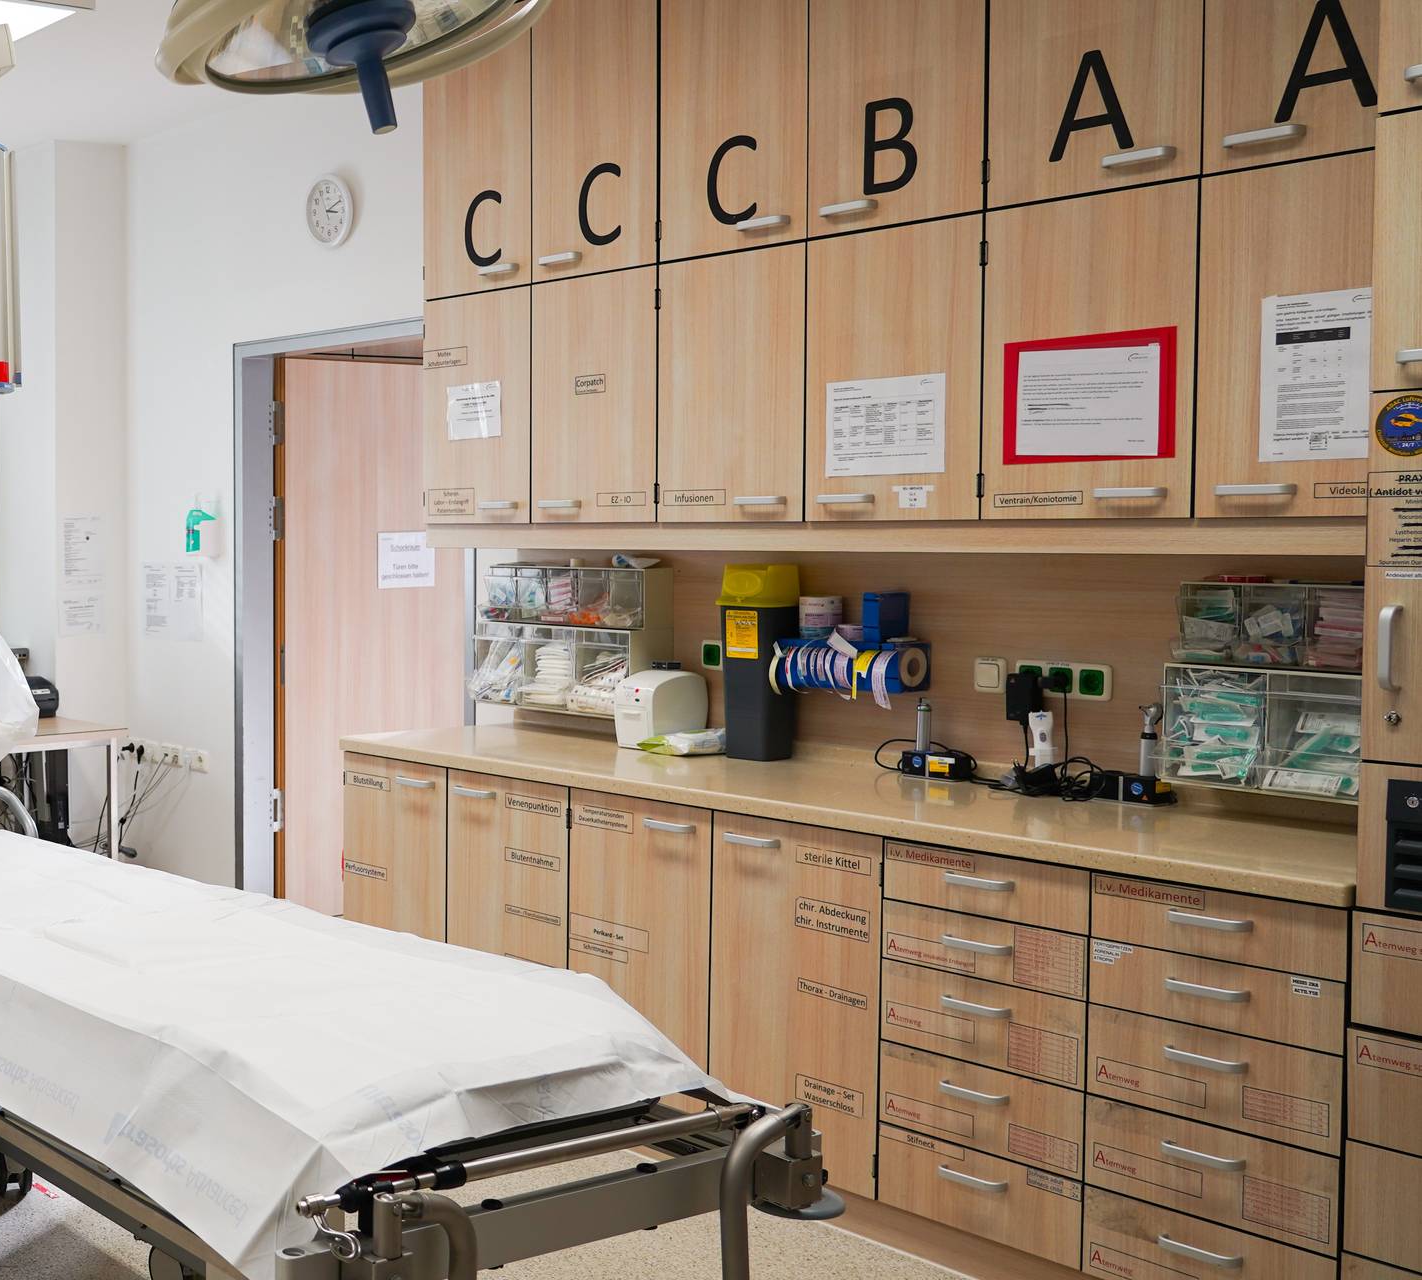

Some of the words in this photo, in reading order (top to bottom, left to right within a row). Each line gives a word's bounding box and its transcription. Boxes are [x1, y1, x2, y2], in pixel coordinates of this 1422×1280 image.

[1274, 0, 1377, 123] A
[1048, 49, 1134, 163] A
[863, 97, 918, 195] B
[707, 135, 756, 225] C
[579, 162, 621, 245] C
[464, 189, 501, 266] C
[576, 378, 604, 388] Corpatch
[674, 493, 714, 503] Infusionen
[999, 495, 1077, 505] Ventrain/Koniotomie
[1375, 487, 1412, 496] Antidot
[353, 775, 383, 790] Blutstillung
[507, 796, 559, 814] Venenpunktion
[582, 806, 624, 820] Temperatursonden
[511, 851, 554, 868] Blutentnahme
[804, 851, 833, 865] sterile
[835, 856, 860, 870] Kittel
[889, 848, 903, 859] i.v.
[905, 850, 971, 869] Medikamente
[345, 862, 386, 879] Perfusorsysteme
[1099, 880, 1116, 893] i.v.
[1119, 883, 1200, 906] Medikamente
[798, 901, 817, 912] chir.
[819, 905, 867, 925] Abdeckung
[593, 928, 613, 939] Perikard
[796, 915, 814, 927] chir.
[816, 919, 869, 940] Instrumente
[888, 938, 922, 958] Atemweg
[1365, 931, 1417, 955] Atemweg
[799, 980, 823, 994] Thorax
[829, 990, 866, 1007] Drainagen
[888, 1007, 922, 1027] Atemweg
[1358, 1045, 1411, 1070] Atemweg
[1097, 1064, 1140, 1088] Atemweg
[804, 1079, 836, 1096] Drainage
[843, 1089, 855, 1101] Set
[803, 1091, 855, 1114] Wasserschloss
[887, 1099, 921, 1120] Atemweg
[906, 1134, 935, 1150] Stifneck
[1095, 1150, 1138, 1175] Atemweg
[1091, 1250, 1133, 1276] Atemweg
